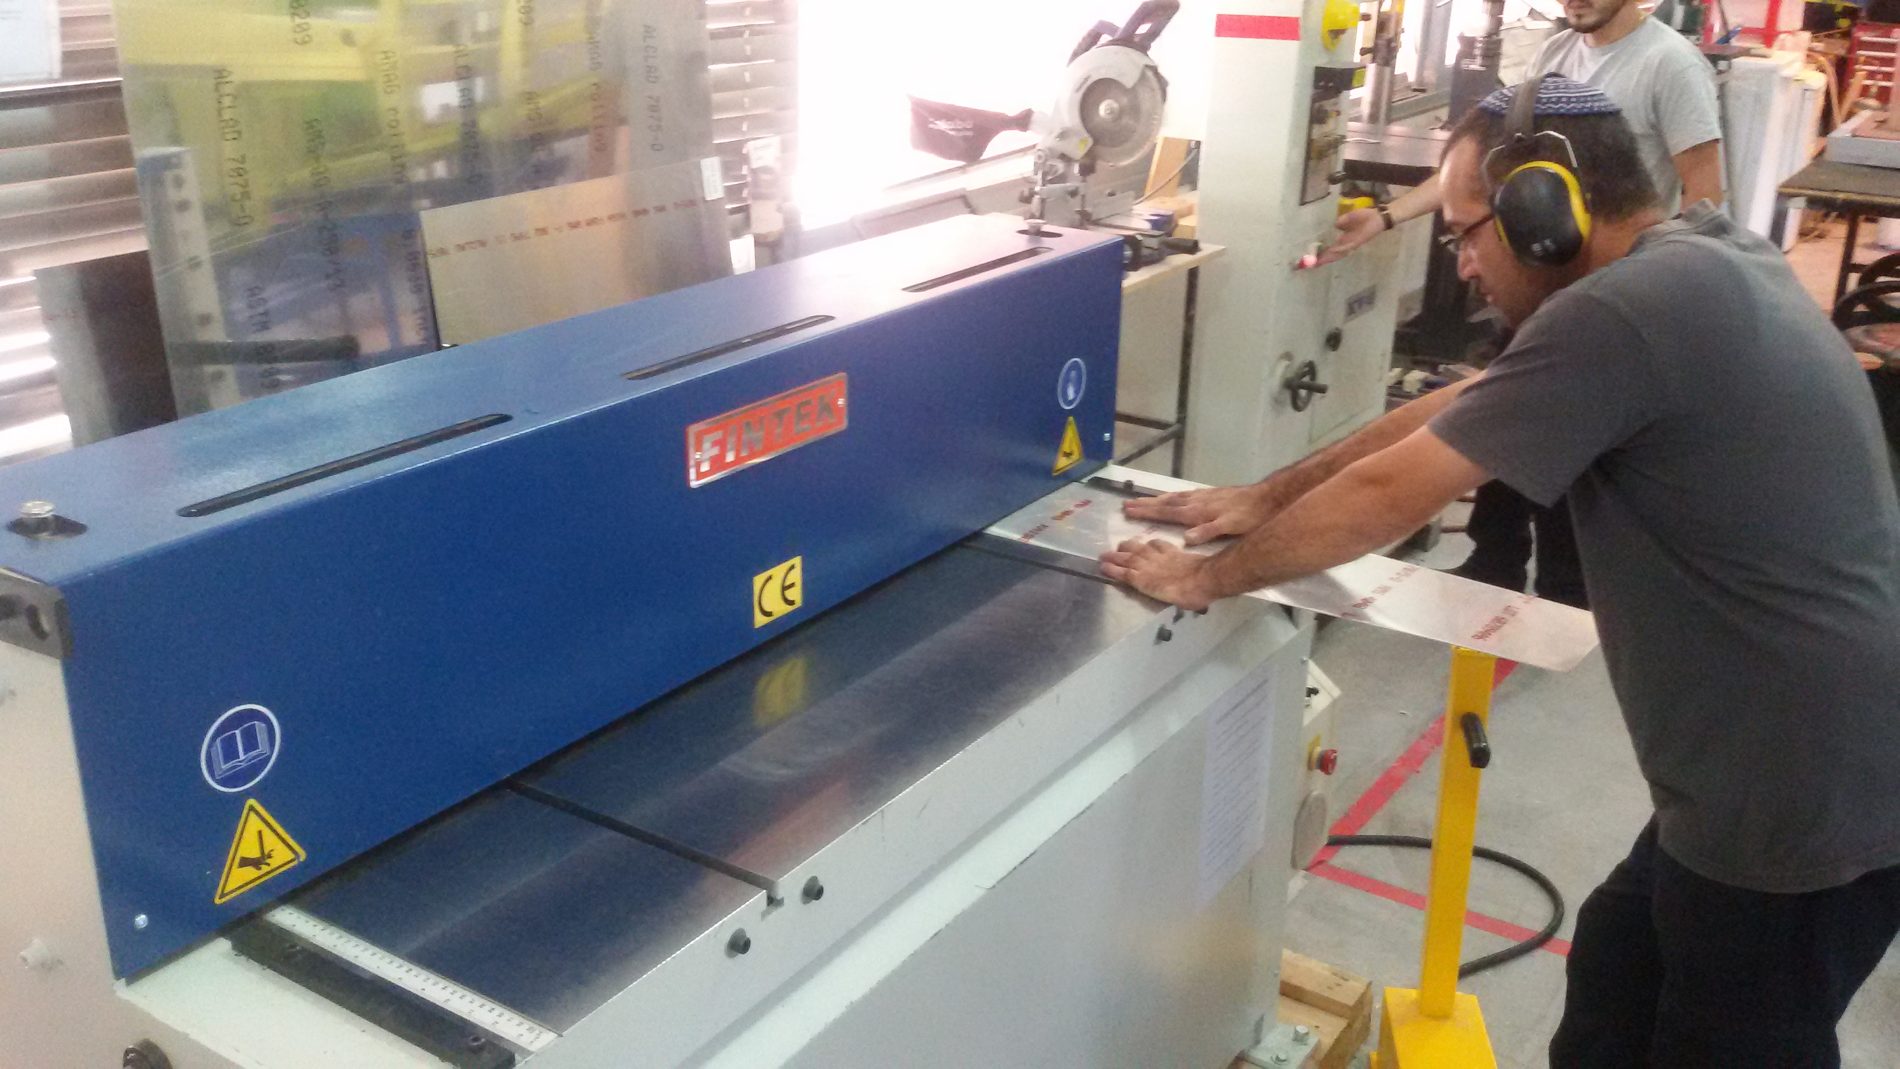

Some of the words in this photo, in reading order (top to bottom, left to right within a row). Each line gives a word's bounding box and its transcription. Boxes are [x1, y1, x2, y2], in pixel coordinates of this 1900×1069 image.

[213, 67, 242, 142] ALCLAD
[699, 389, 837, 473] FINTEK
[758, 563, 796, 618] CE
